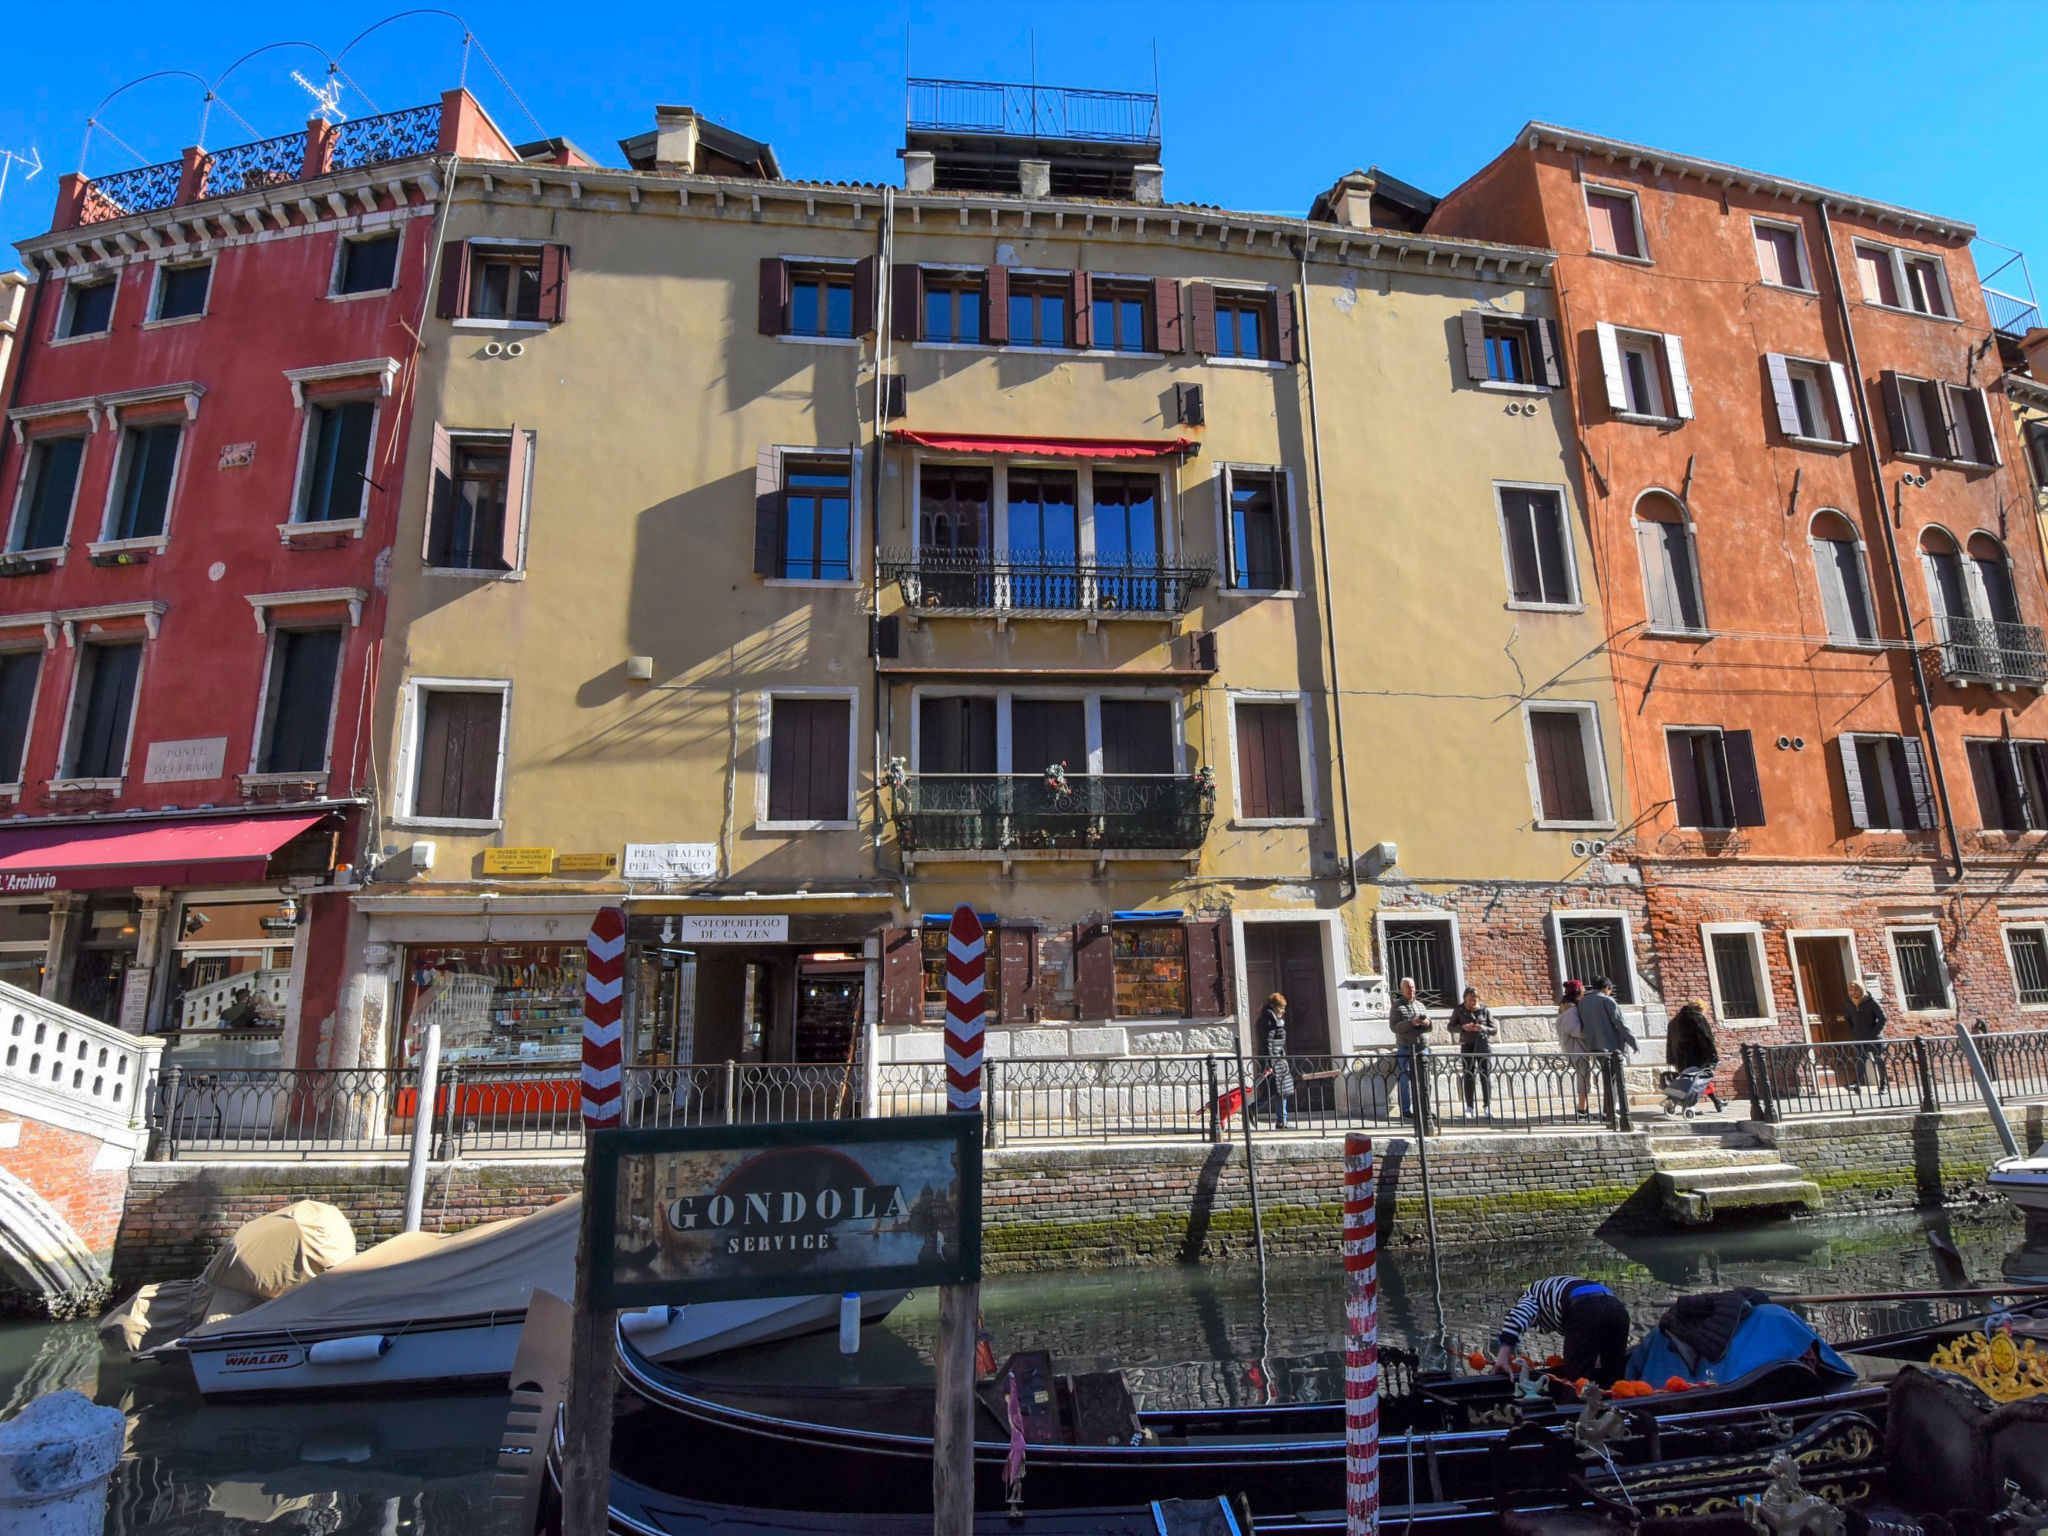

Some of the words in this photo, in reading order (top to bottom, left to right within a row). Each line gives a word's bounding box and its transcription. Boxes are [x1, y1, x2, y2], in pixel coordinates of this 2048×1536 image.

[167, 747, 206, 757] PONTE
[633, 849, 656, 858] PER
[667, 849, 711, 858] RIALTO
[628, 862, 650, 871] PER
[691, 918, 780, 928] SOTOPORTEGO
[701, 929, 717, 939] DE
[747, 929, 770, 939] ZEN
[669, 1186, 911, 1229] GONDOLA
[728, 1234, 829, 1254] SERVICE
[225, 1354, 288, 1366] WHALER
